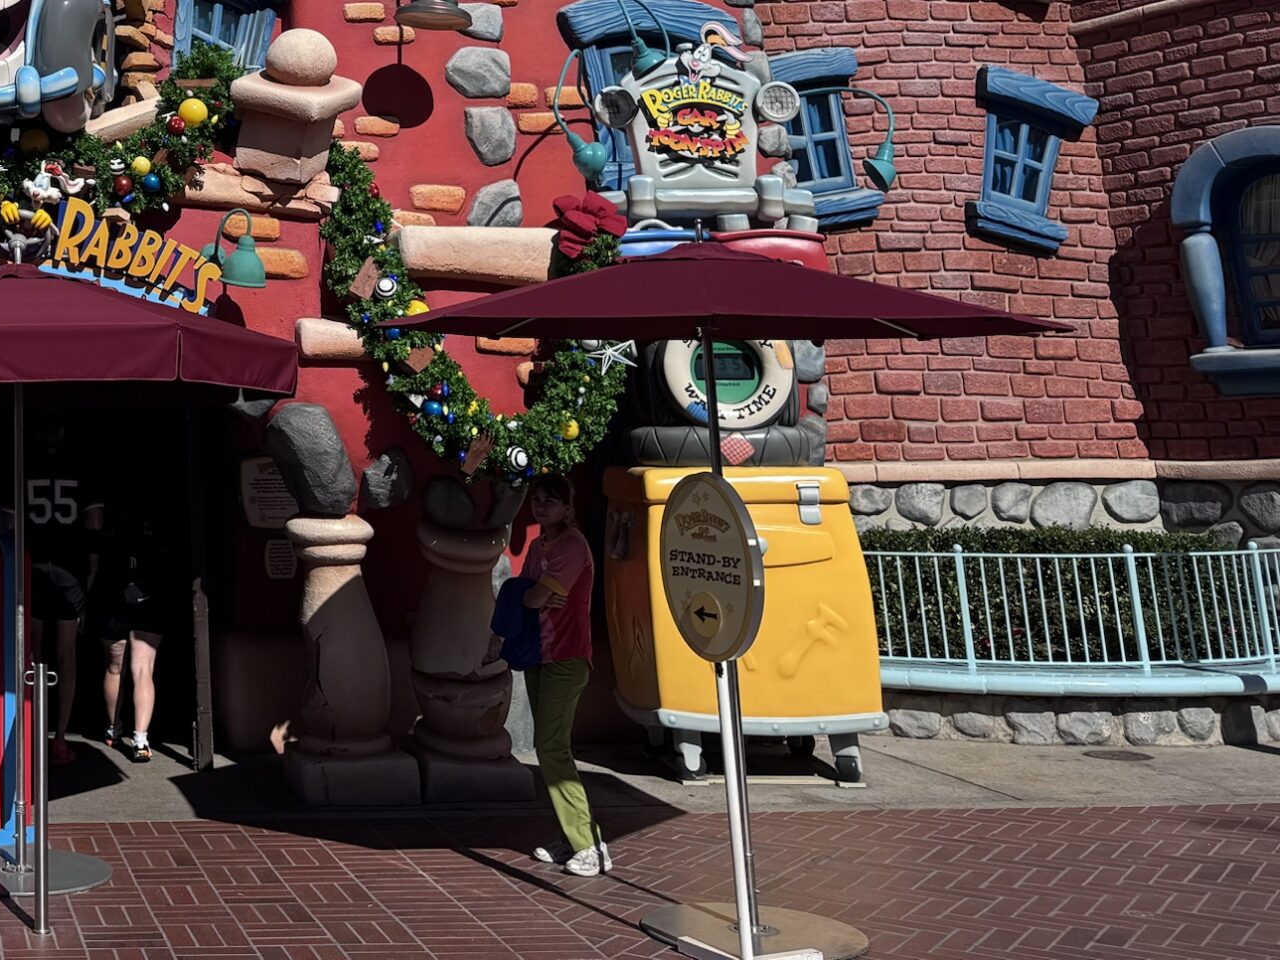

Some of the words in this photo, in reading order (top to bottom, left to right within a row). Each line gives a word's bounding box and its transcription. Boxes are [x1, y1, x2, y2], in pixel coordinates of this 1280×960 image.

[641, 86, 697, 119] ROGER
[676, 107, 719, 130] CAR
[53, 196, 222, 314] RABBIT'S
[732, 384, 777, 420] TIME
[27, 479, 78, 525] 55
[669, 548, 741, 569] STAND-BY
[672, 566, 741, 585] ENTRANCE
